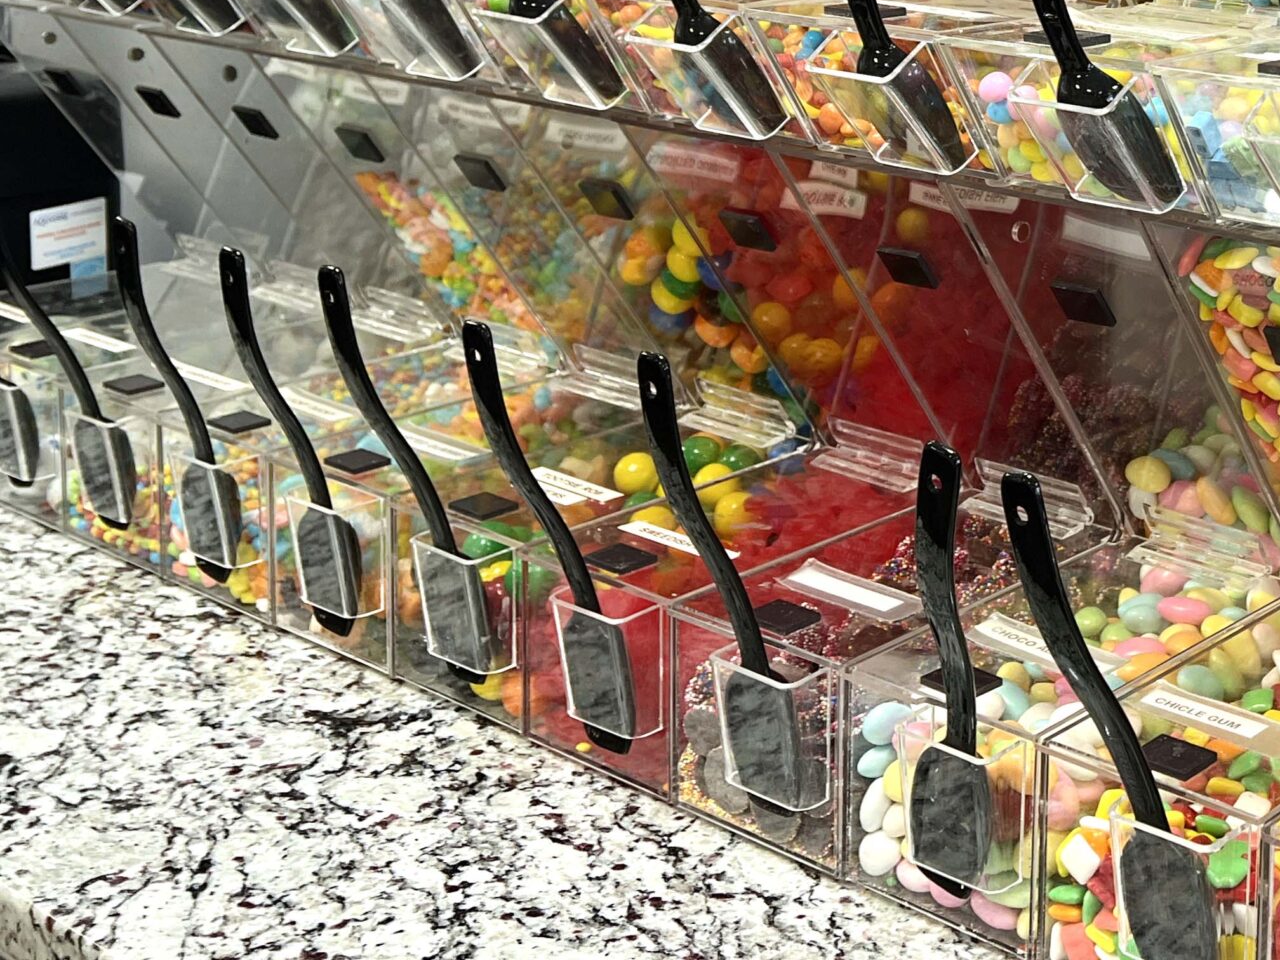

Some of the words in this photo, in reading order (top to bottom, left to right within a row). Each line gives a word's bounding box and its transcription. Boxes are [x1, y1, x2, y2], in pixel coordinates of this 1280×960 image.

[990, 624, 1037, 649] CHOCO
[1154, 695, 1204, 720] CHICLE
[1208, 713, 1243, 731] GUM
